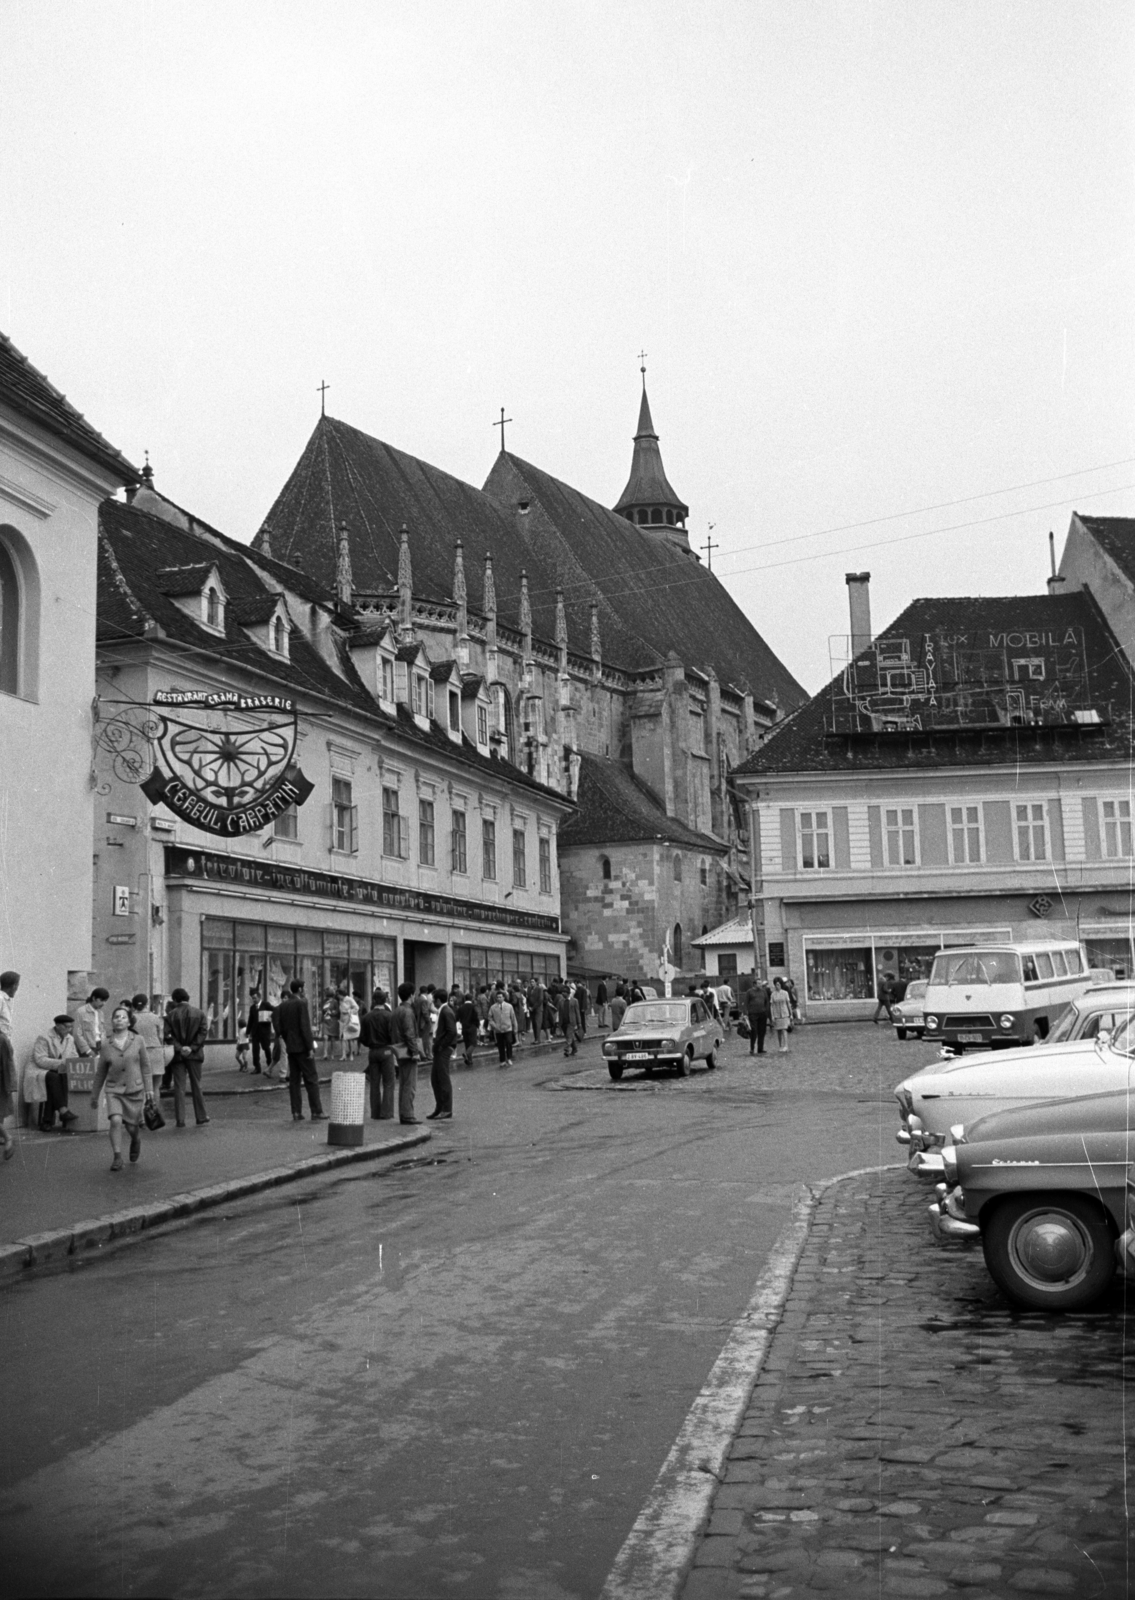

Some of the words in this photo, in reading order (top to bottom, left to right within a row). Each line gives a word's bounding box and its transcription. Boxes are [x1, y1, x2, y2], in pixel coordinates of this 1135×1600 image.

[924, 634, 938, 706] TRAVIATA
[208, 692, 238, 704] CRAMA
[240, 696, 292, 709] BRASERIE
[164, 781, 221, 830] CERBUL
[227, 780, 300, 832] CARPATIN
